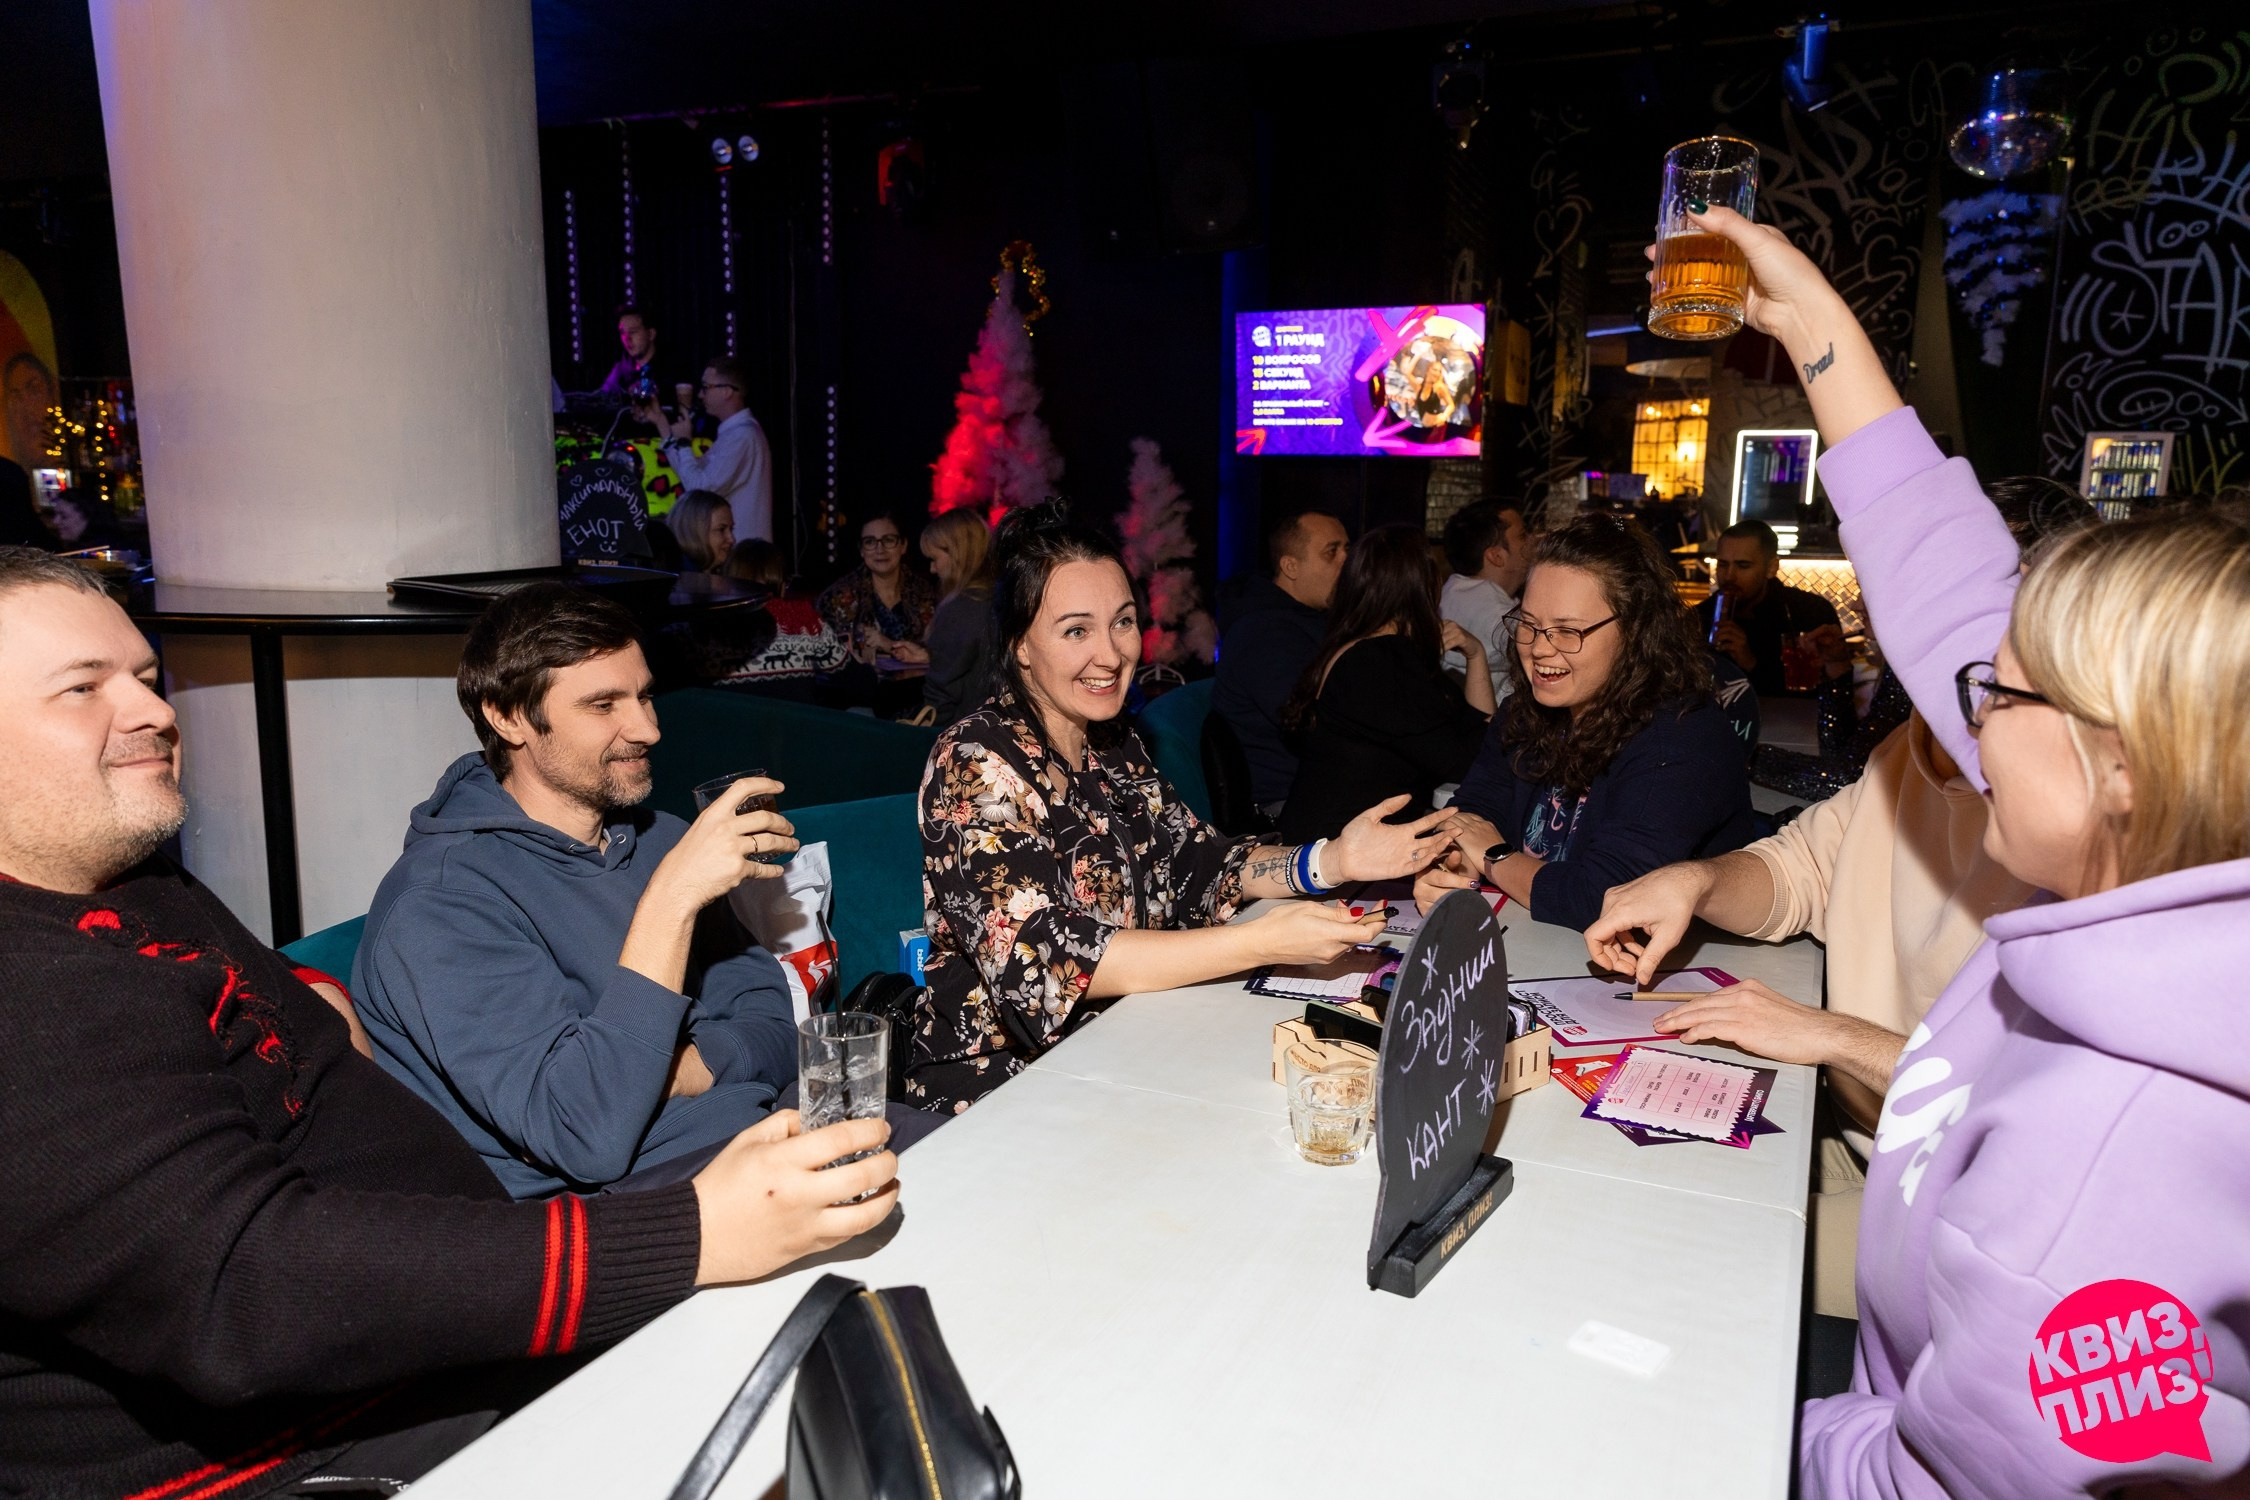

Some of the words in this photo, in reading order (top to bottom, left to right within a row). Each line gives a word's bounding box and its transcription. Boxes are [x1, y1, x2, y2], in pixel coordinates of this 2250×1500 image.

[1275, 334, 1282, 346] 1
[1283, 333, 1325, 347] РАУНД
[1264, 354, 1321, 365] ВОПРОСОВ
[1264, 367, 1304, 378] СЕКУНД
[1252, 380, 1259, 390] 2
[1260, 379, 1311, 390] ВАРИАНТА
[567, 518, 624, 546] ЕНОТ
[916, 948, 924, 972] bbk
[1530, 992, 1562, 1014] ЗАПИСИ
[1558, 1011, 1580, 1025] ДЛЯ
[1406, 1078, 1466, 1180] КАНТ
[1440, 1221, 1467, 1259] КВИЗ,
[1468, 1191, 1493, 1230] ПЛИЗ!
